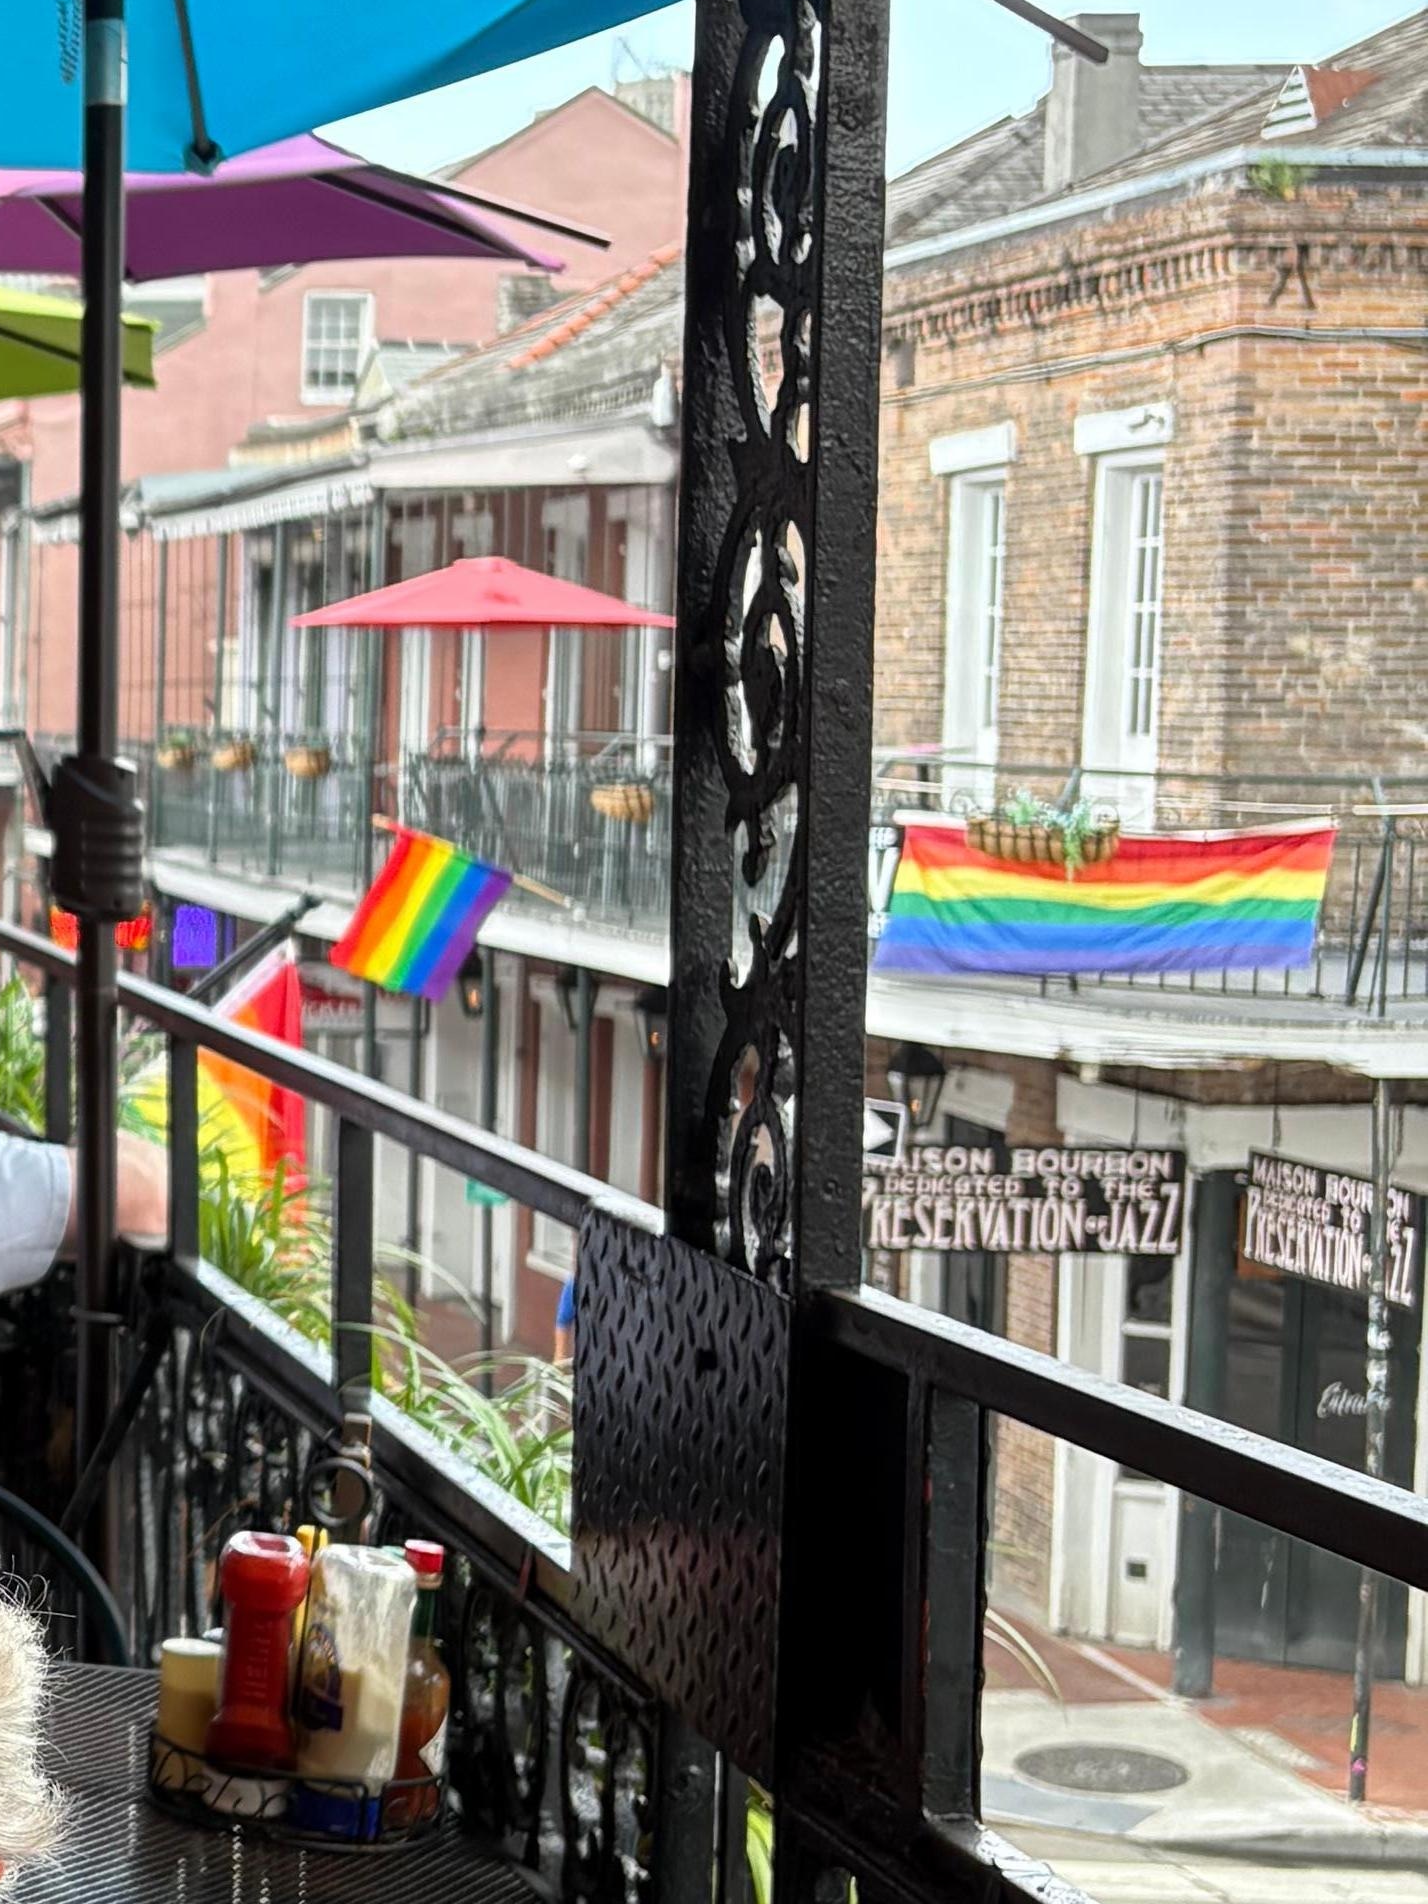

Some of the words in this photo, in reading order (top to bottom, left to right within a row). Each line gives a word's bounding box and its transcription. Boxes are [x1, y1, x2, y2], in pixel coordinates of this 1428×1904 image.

[884, 1174, 1024, 1197] DEDICATED
[1043, 1176, 1084, 1200] TO
[1101, 1176, 1156, 1203] THE
[1011, 1148, 1174, 1181] BOURBON
[1253, 1154, 1317, 1198] MAISON
[1325, 1173, 1411, 1223] BOURON
[1085, 1215, 1108, 1234] OF
[1097, 1182, 1179, 1253] JAZZ
[1244, 1185, 1364, 1289] PRESERVATION
[1263, 1186, 1331, 1225] DEDICATED
[1340, 1203, 1363, 1234] TO
